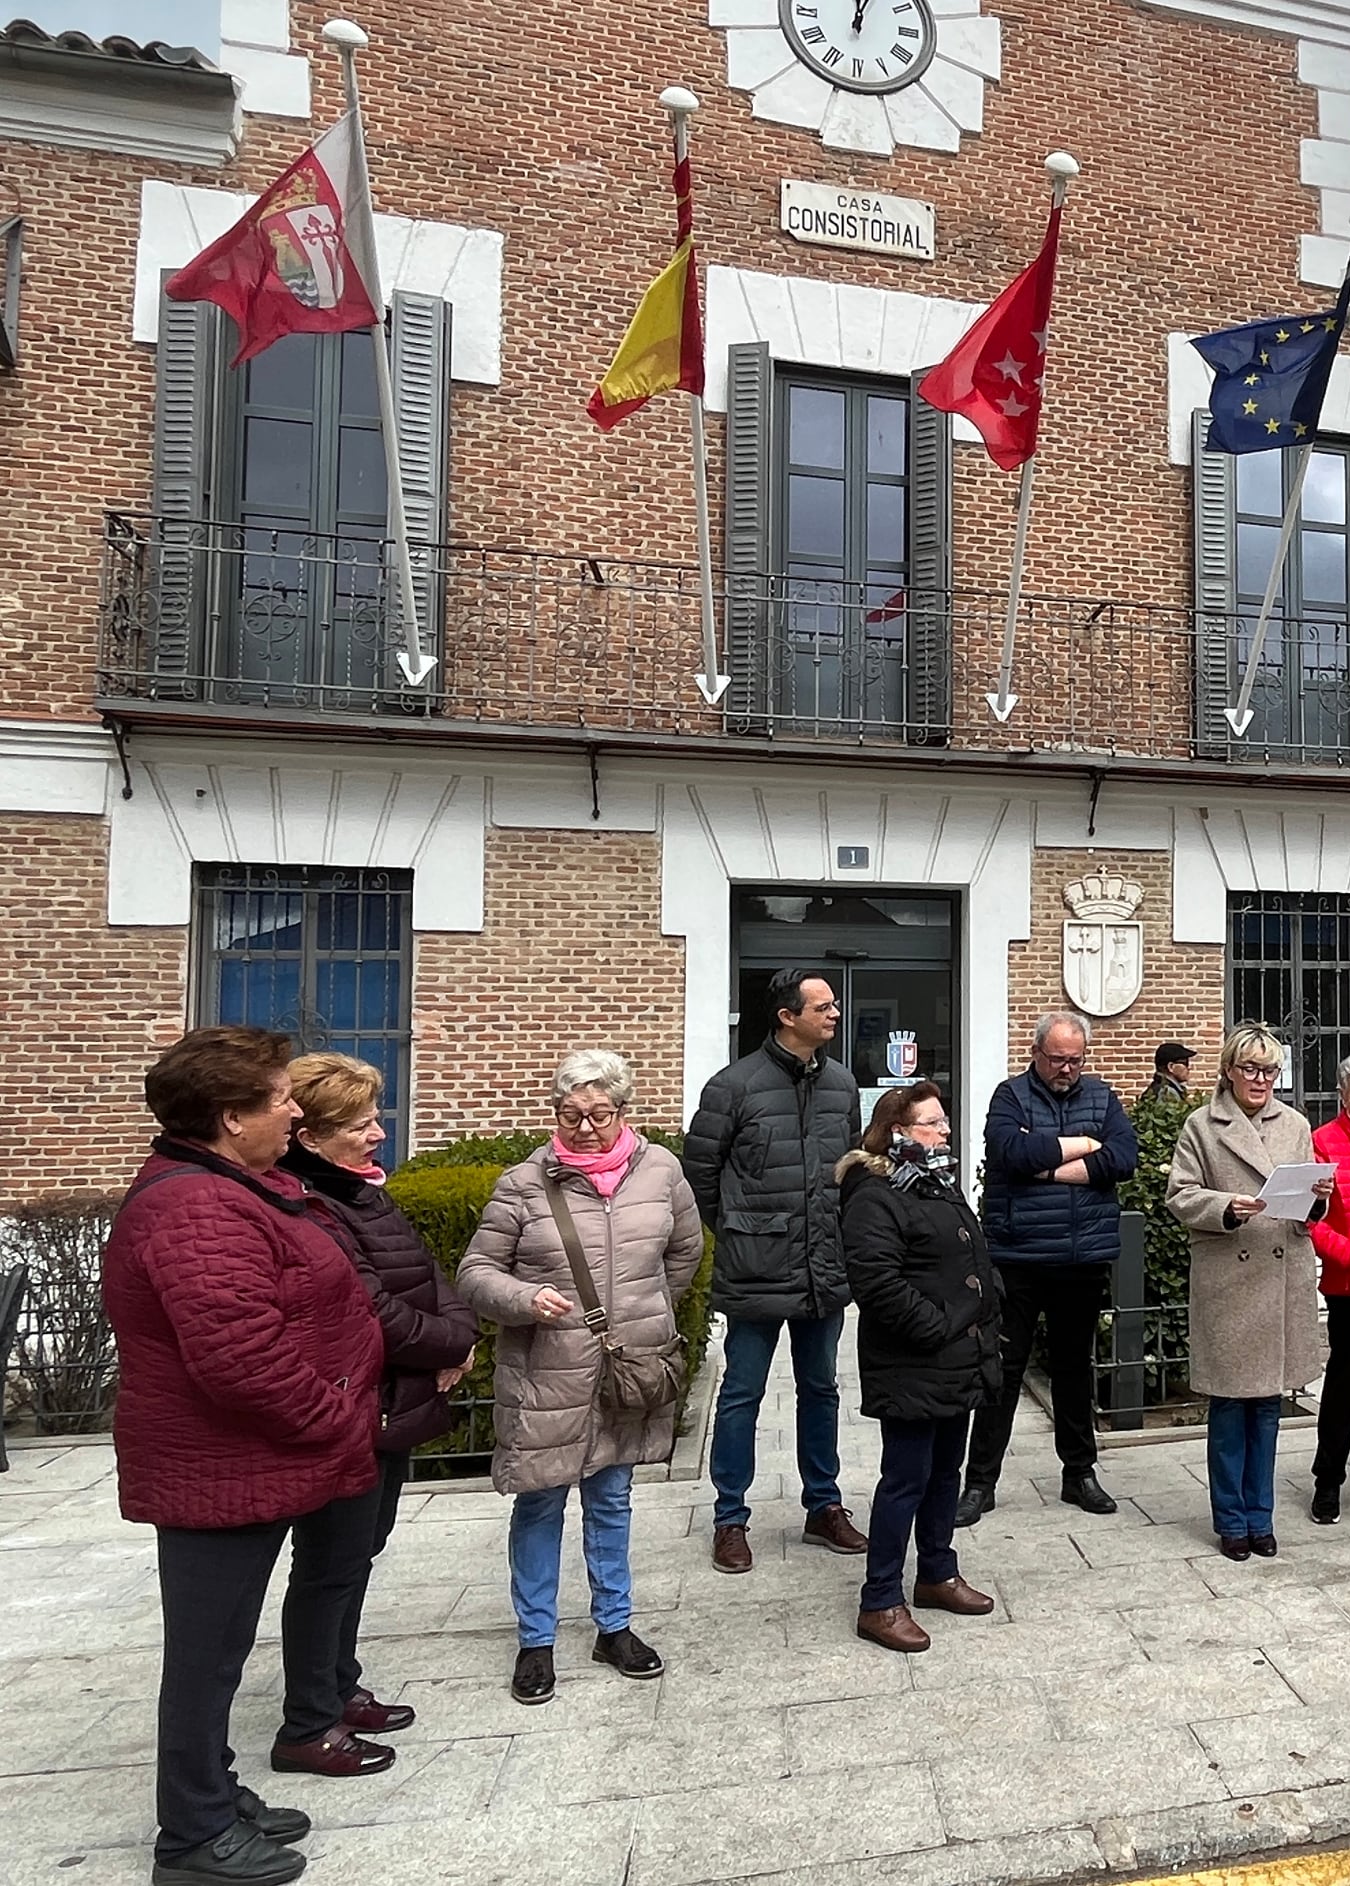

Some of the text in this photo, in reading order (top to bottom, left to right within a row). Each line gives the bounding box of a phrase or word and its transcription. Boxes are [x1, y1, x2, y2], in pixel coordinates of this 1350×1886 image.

[837, 195, 883, 214] CASA
[788, 206, 927, 250] CONSISTORIAL
[850, 850, 857, 865] 1
